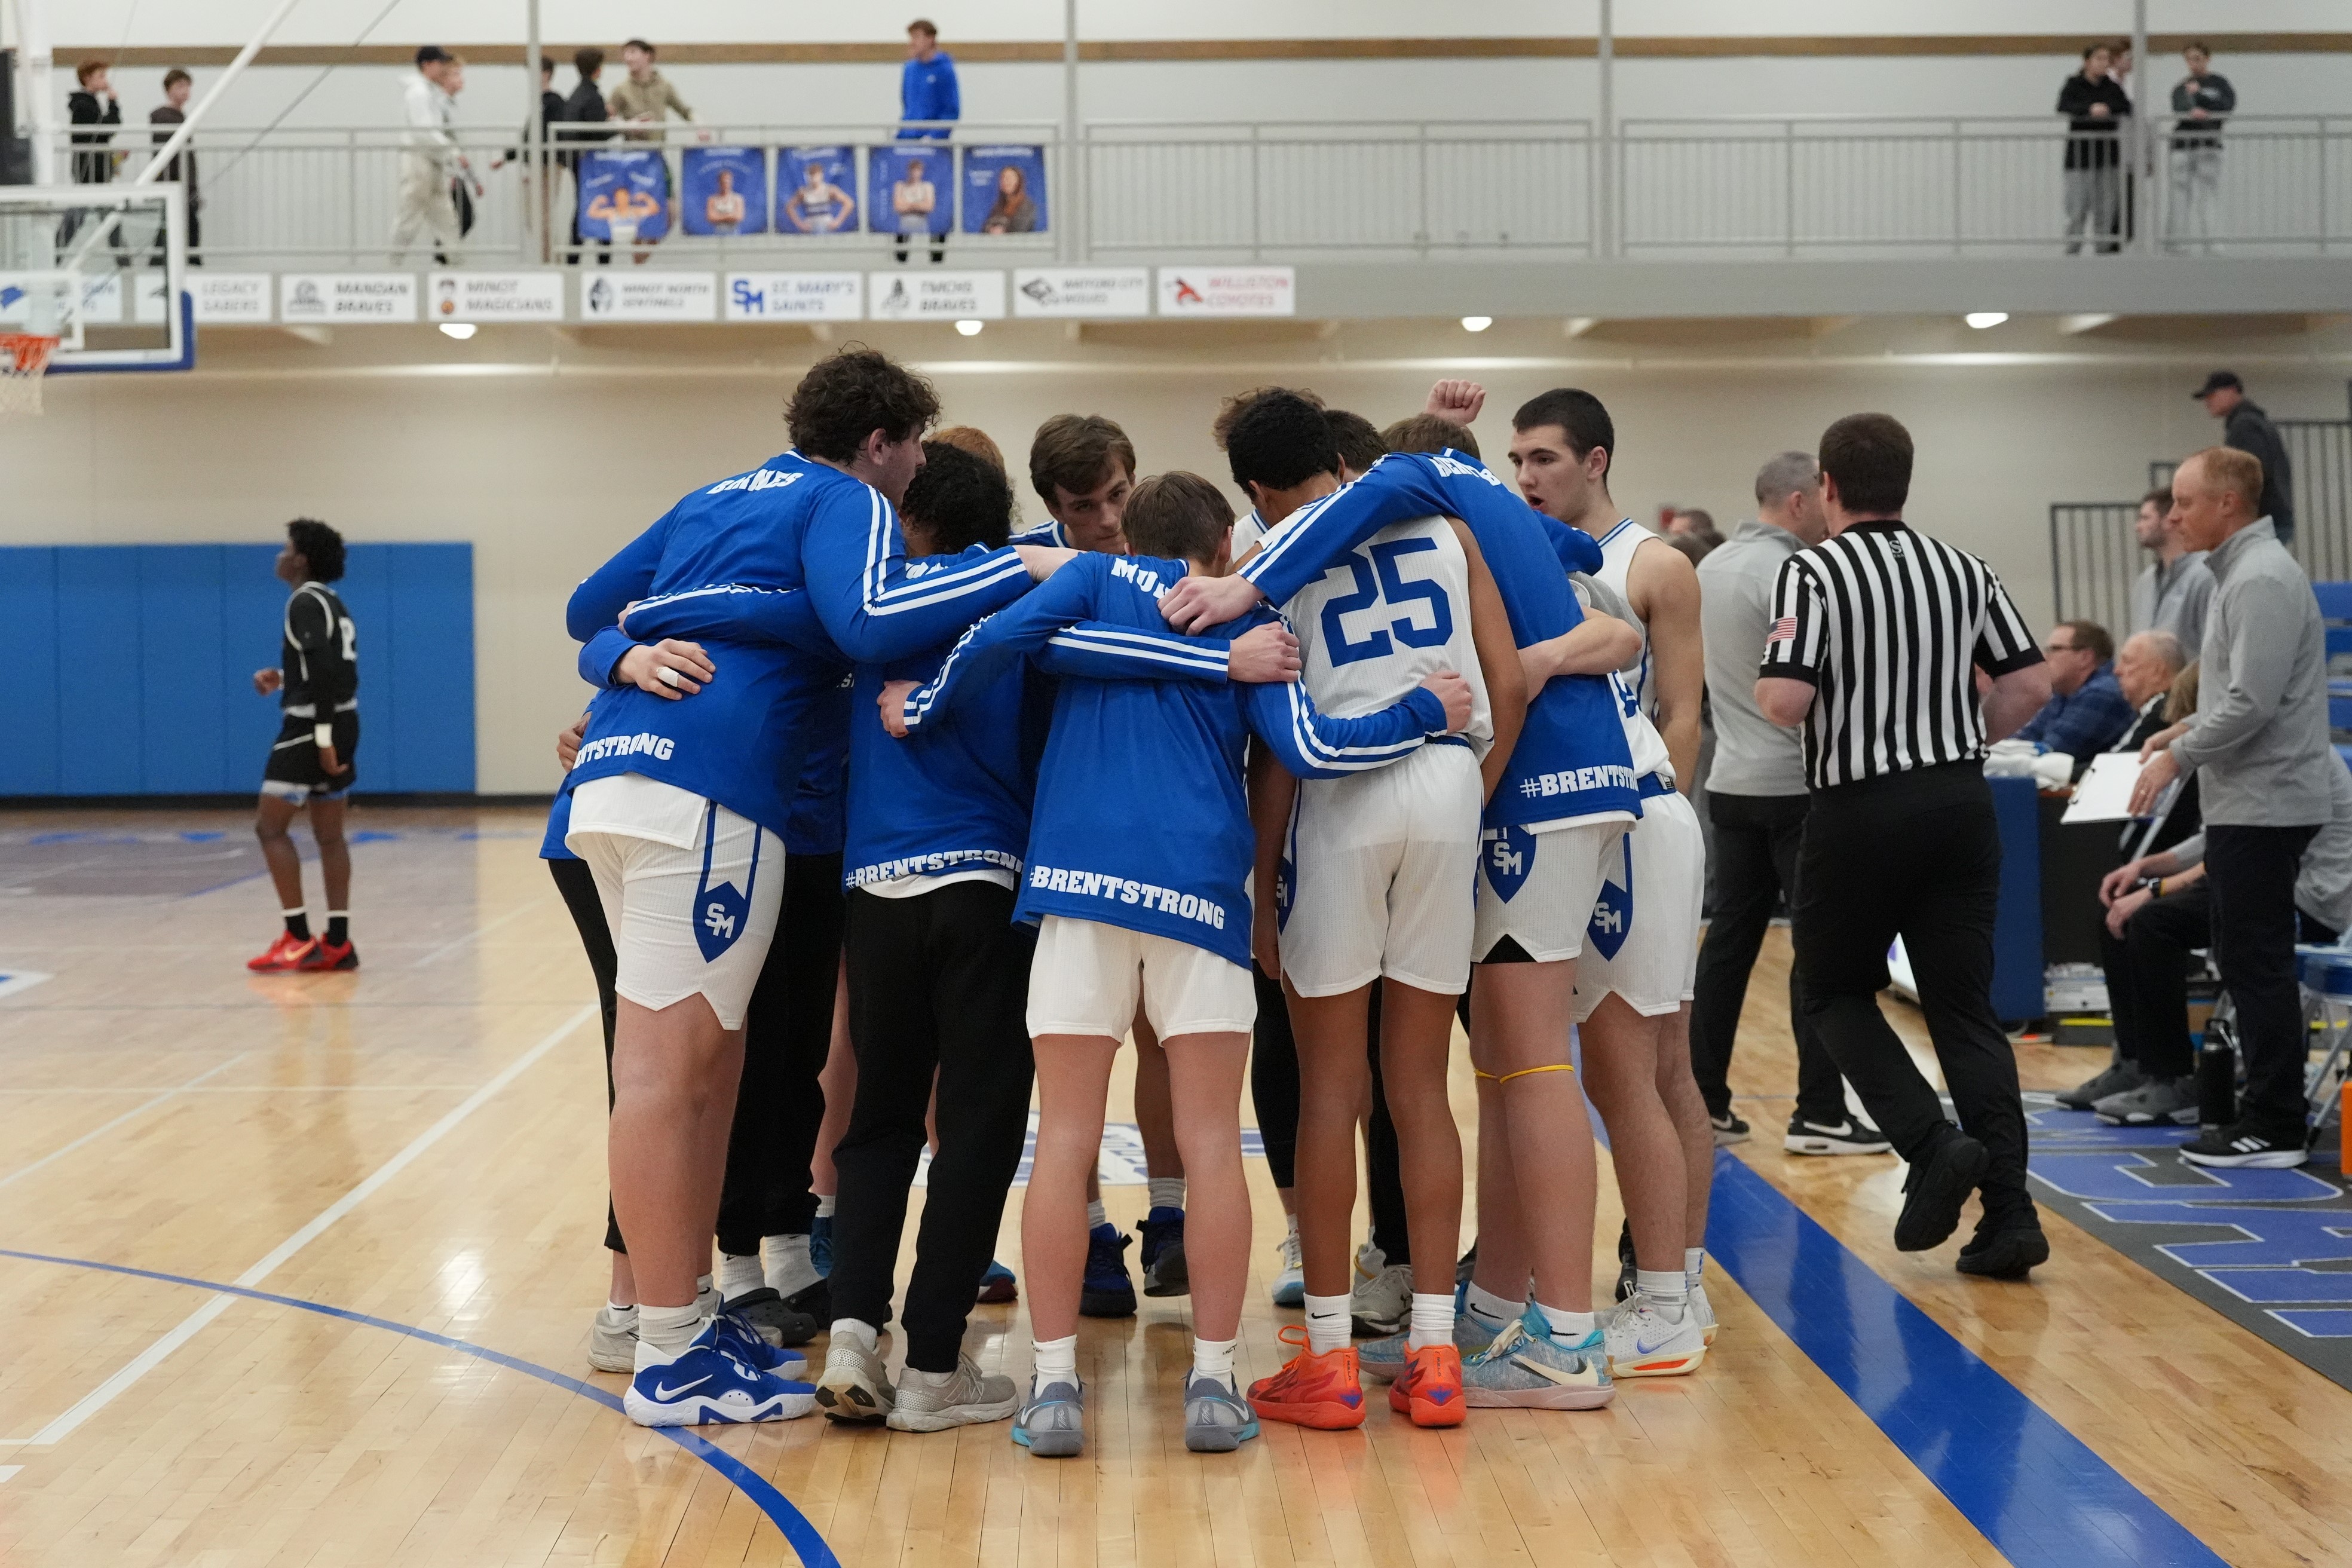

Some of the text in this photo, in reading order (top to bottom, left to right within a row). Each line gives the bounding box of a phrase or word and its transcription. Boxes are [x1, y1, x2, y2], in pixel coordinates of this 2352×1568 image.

[335, 281, 409, 294] MANDAN
[466, 281, 519, 293] MINOT
[1307, 537, 1453, 668] 25
[1493, 841, 1522, 875] SM
[704, 902, 736, 939] SM
[1594, 902, 1622, 934] SM
